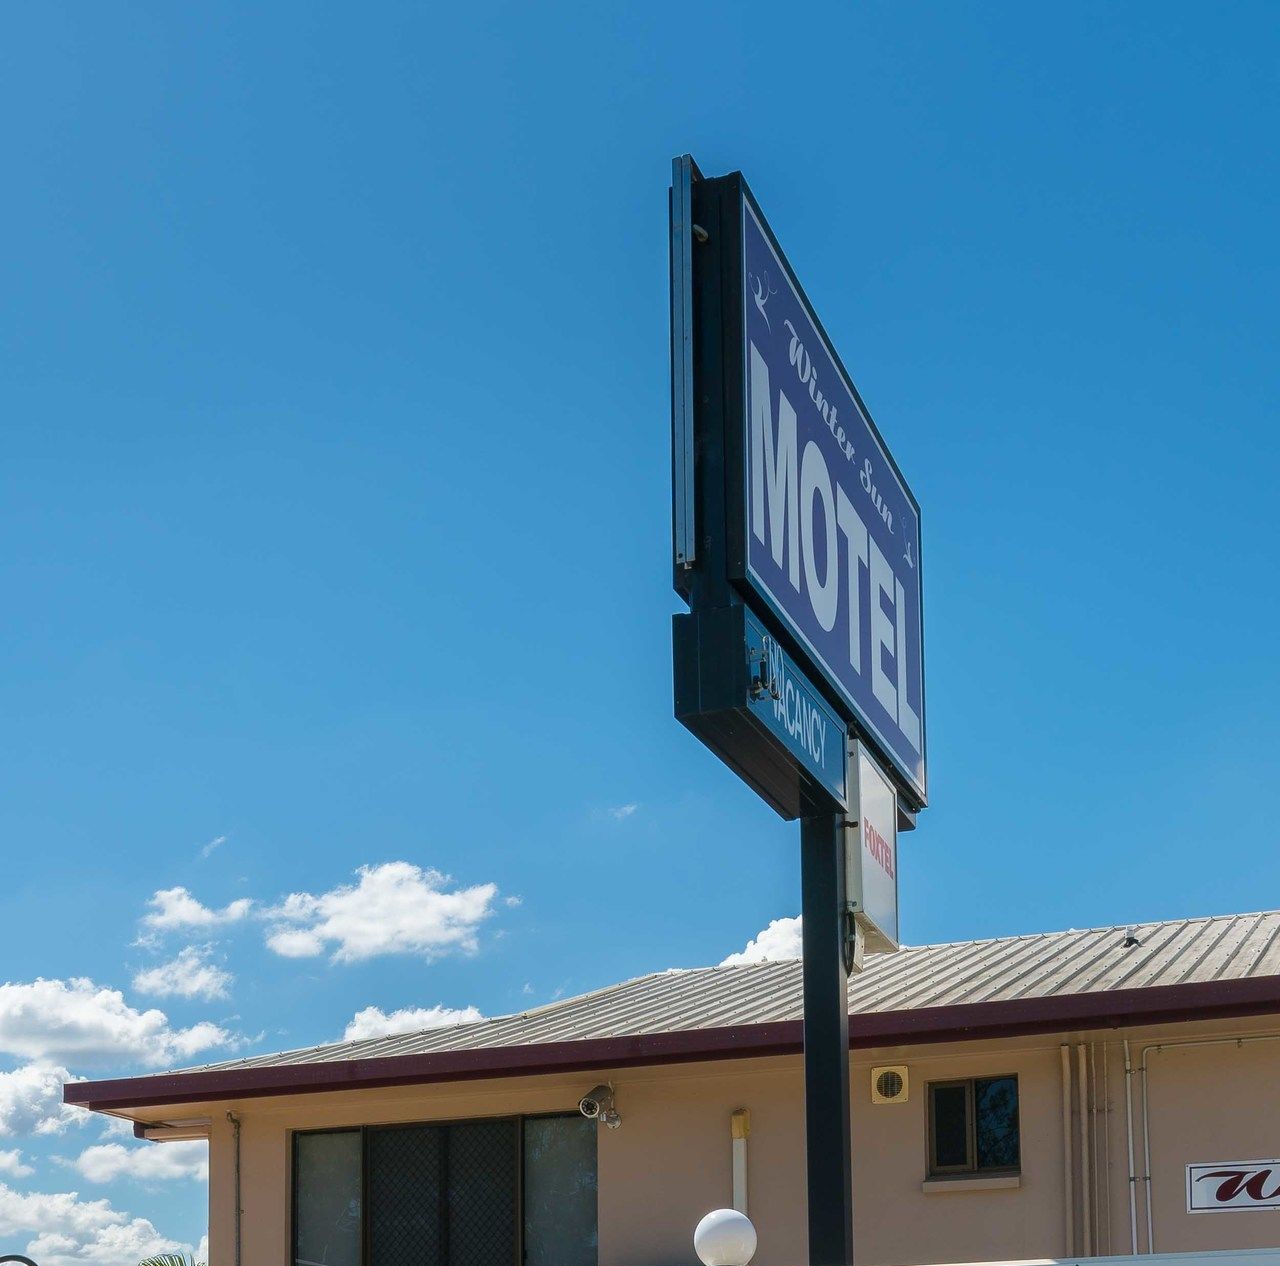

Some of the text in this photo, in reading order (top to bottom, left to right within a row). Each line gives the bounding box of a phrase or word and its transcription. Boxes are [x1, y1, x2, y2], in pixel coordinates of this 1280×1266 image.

[784, 319, 896, 535] Winter Sun
[750, 339, 920, 754] MOTEL
[863, 816, 894, 880] FOXTEL
